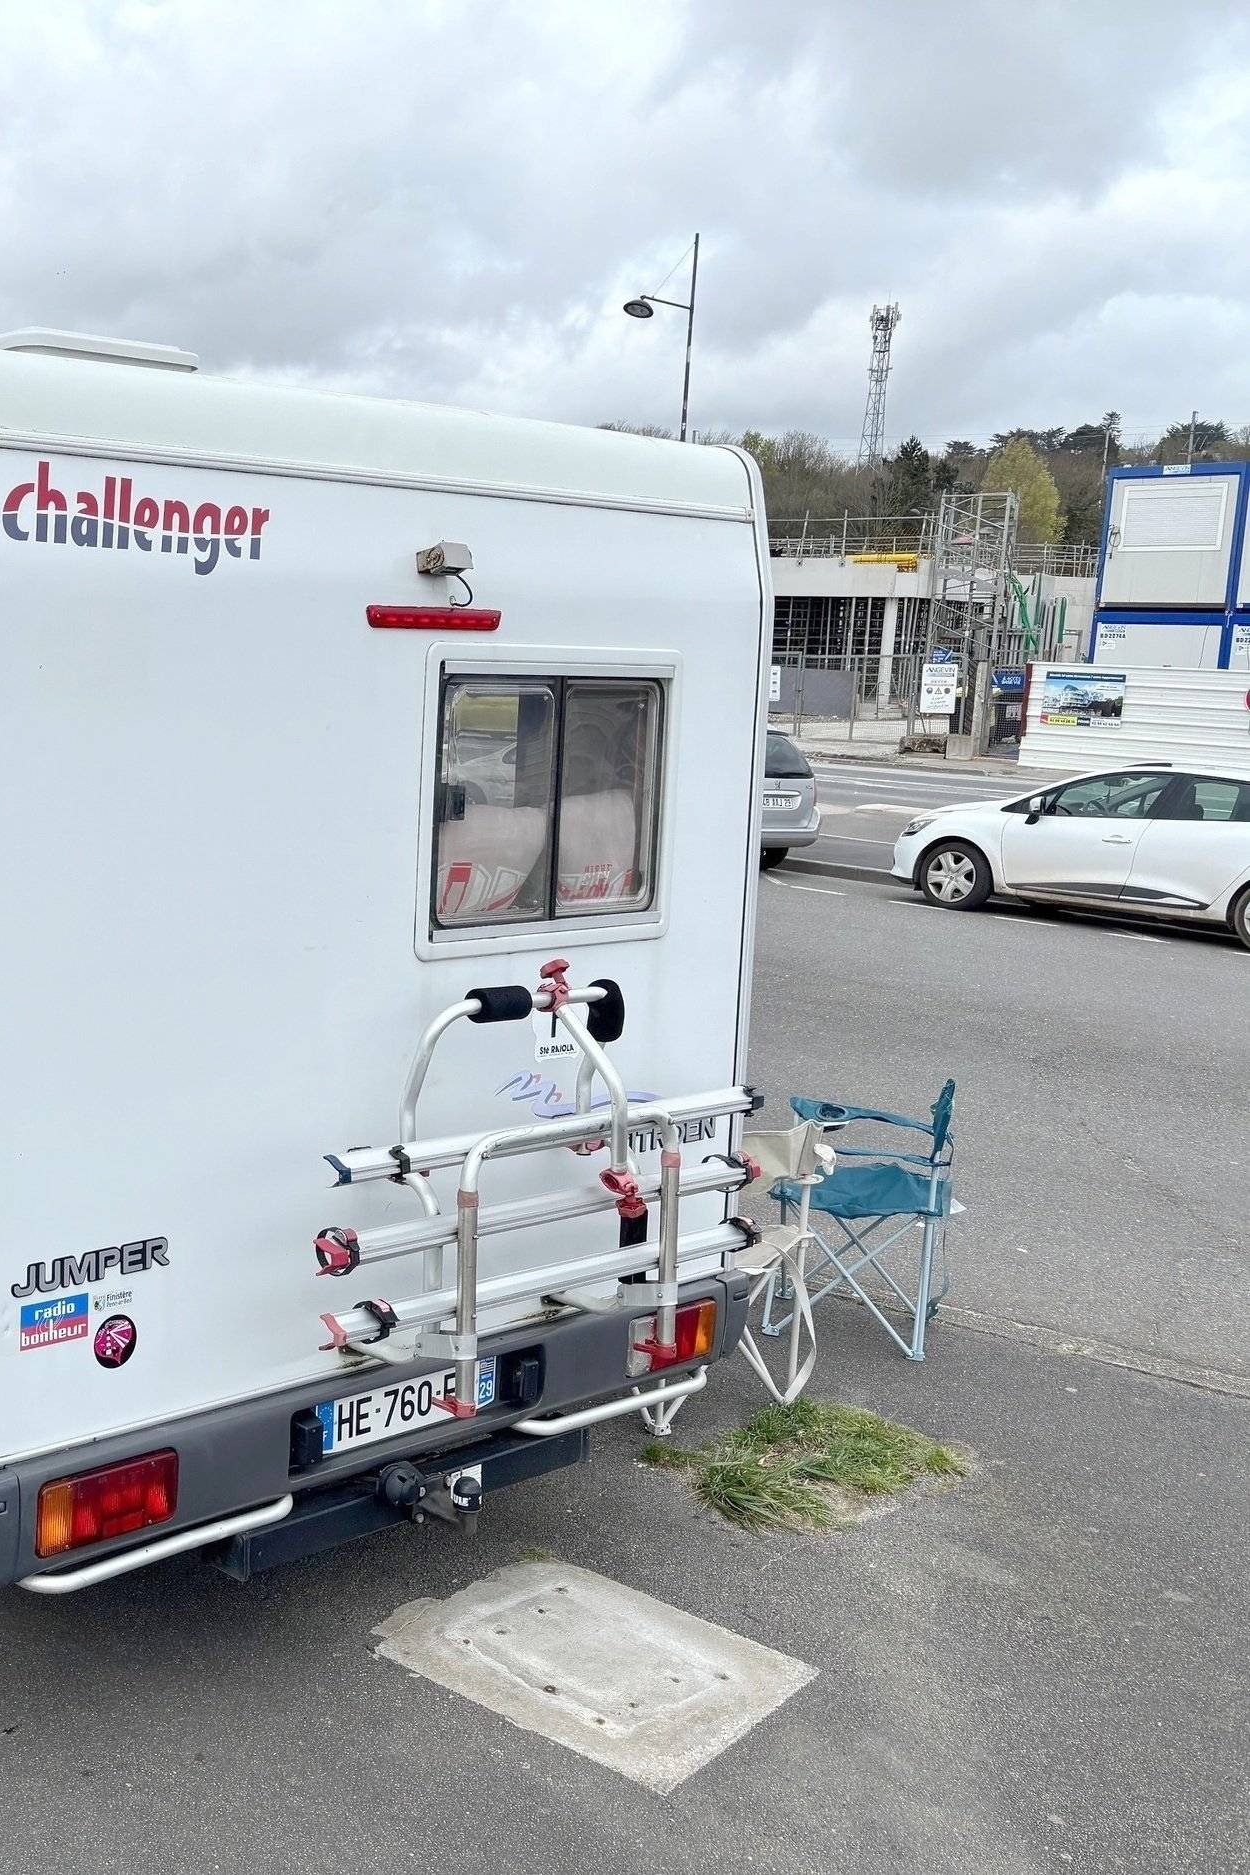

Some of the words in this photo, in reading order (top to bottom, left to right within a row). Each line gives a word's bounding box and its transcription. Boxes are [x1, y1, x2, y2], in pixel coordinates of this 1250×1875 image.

[2, 460, 270, 576] challenger
[11, 1236, 170, 1298] JUMPER
[34, 1301, 75, 1321] radio
[21, 1319, 87, 1348] bonheur
[479, 1379, 493, 1399] 29
